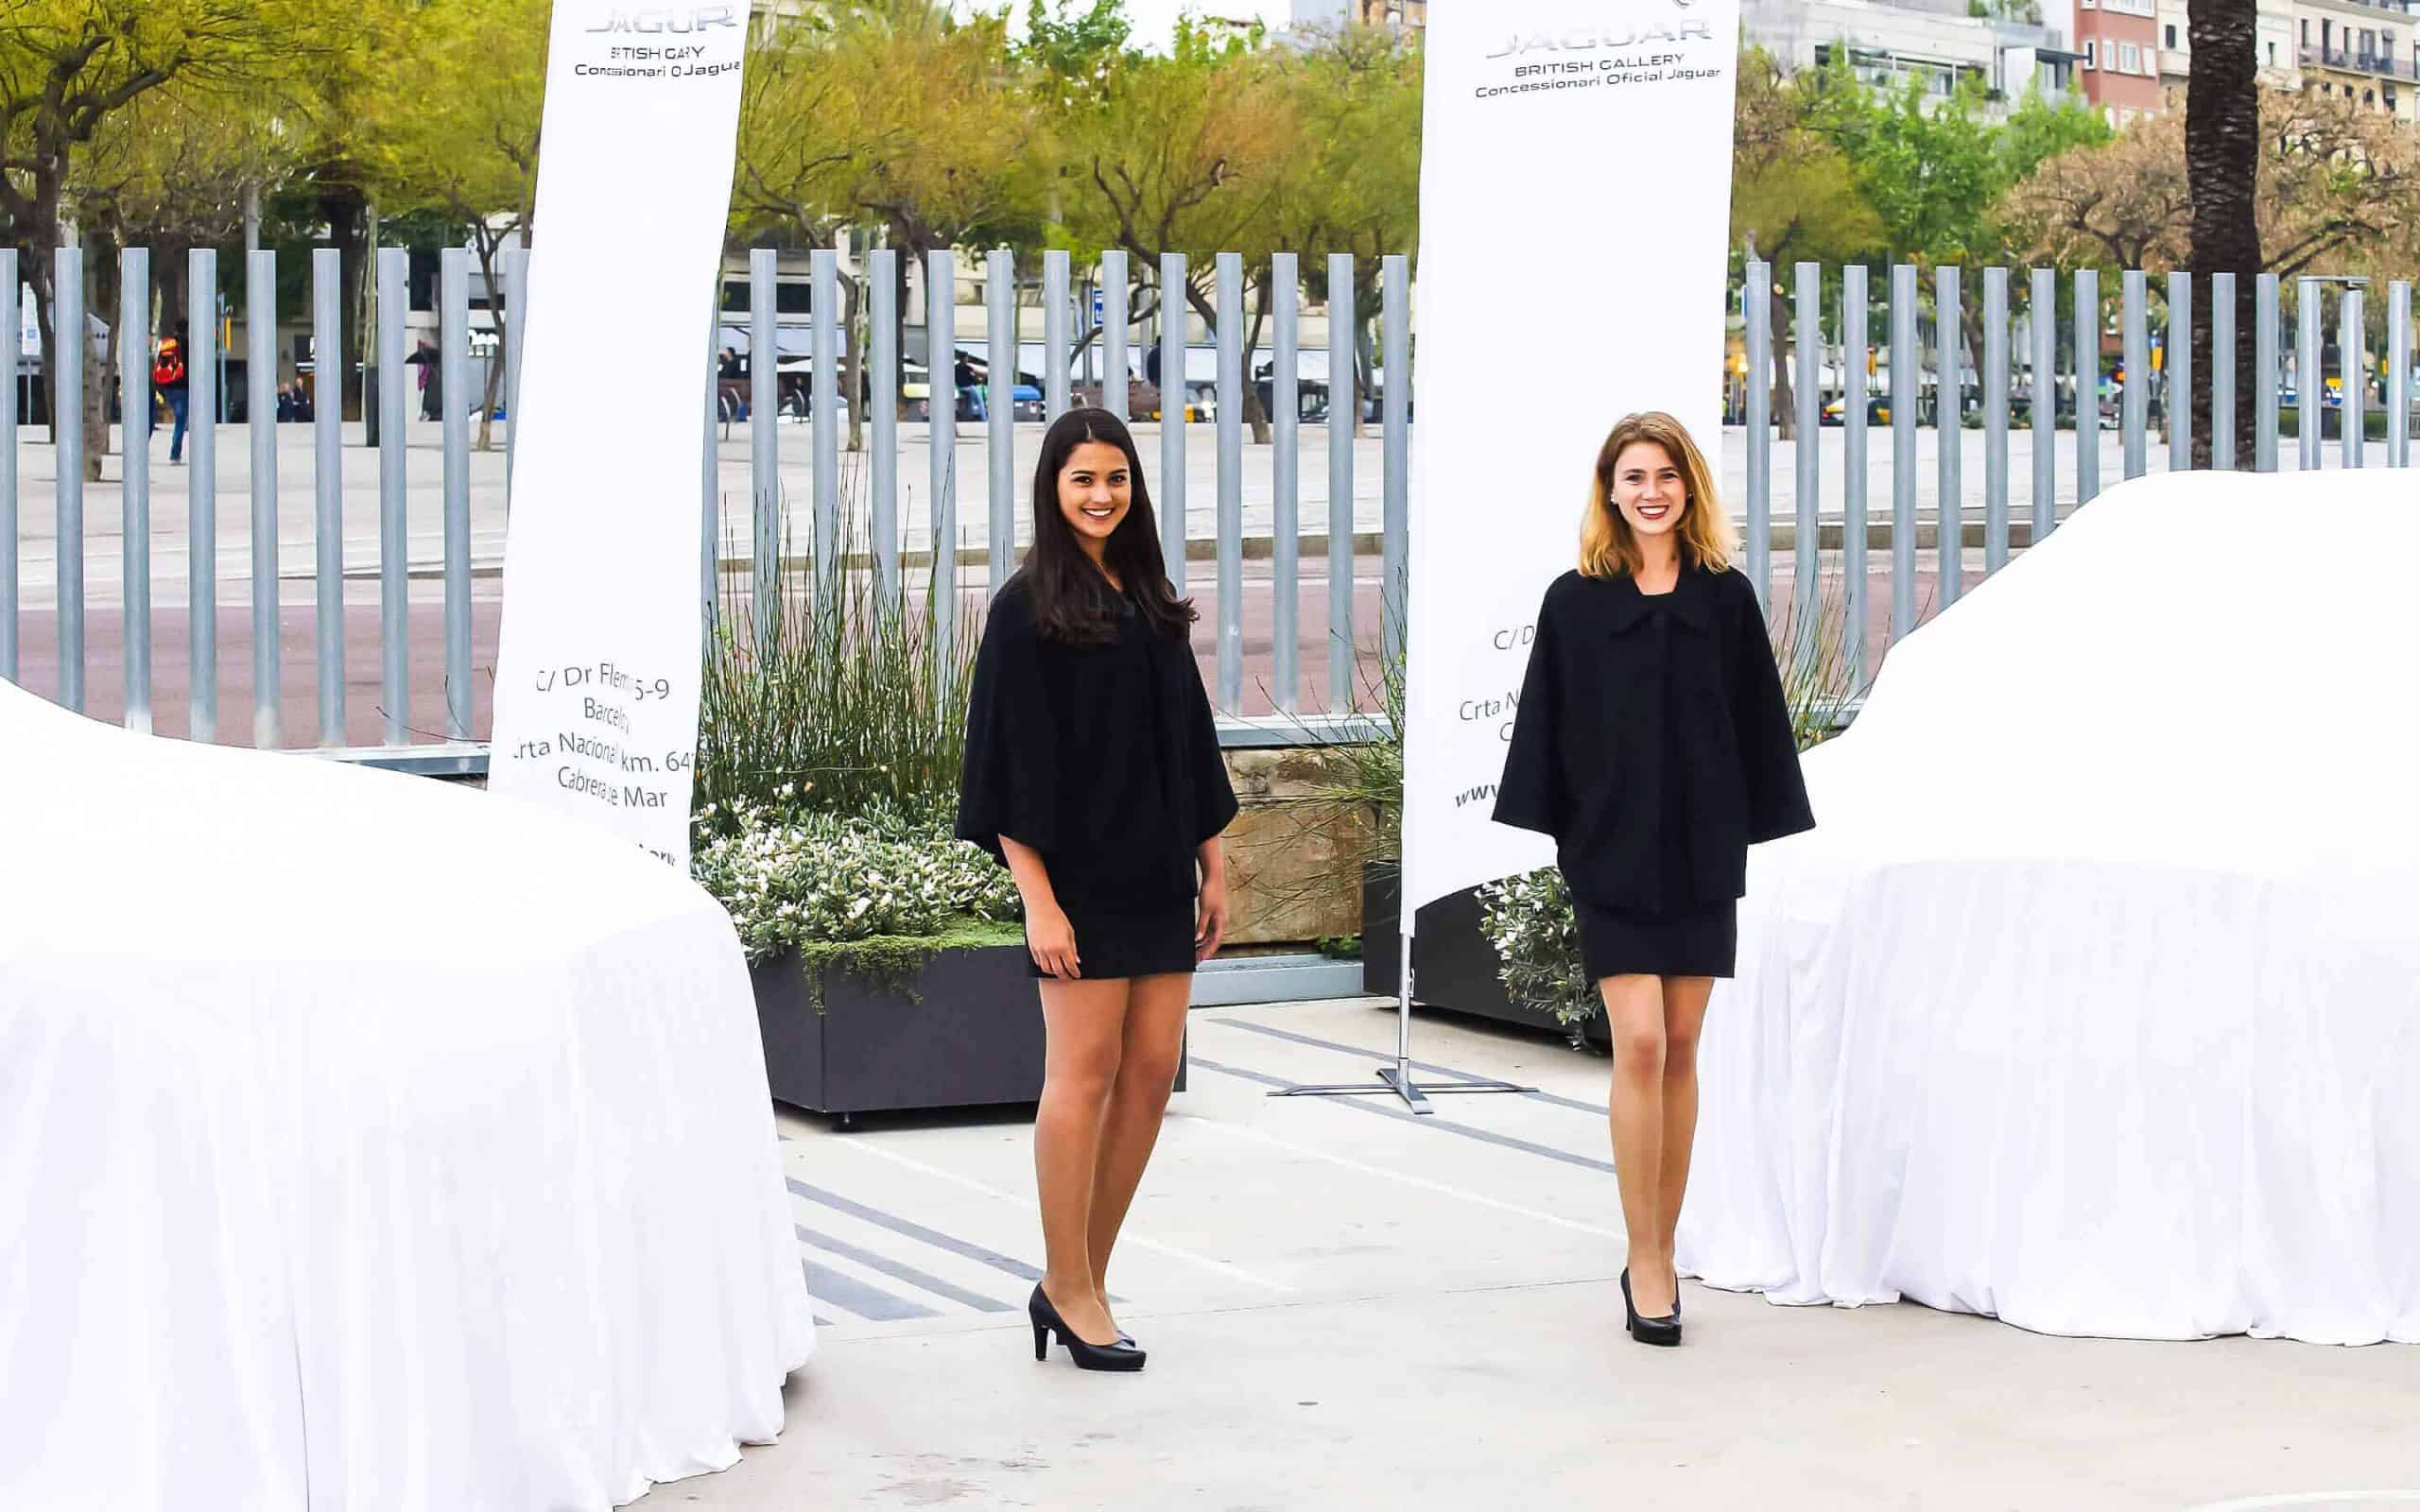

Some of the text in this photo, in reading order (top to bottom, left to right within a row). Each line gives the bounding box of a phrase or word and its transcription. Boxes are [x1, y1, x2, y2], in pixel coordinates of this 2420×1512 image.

[1485, 19, 1713, 59] JAGUAR
[1514, 53, 1685, 77] BRITISH GALLERY
[1475, 67, 1721, 98] Concessionari Oficial Jaguar
[1494, 628, 1518, 650] C/
[564, 666, 593, 686] Dr
[1460, 700, 1501, 721] Crta
[513, 740, 551, 760] rta
[621, 748, 660, 772] km.
[624, 786, 668, 808] Mar
